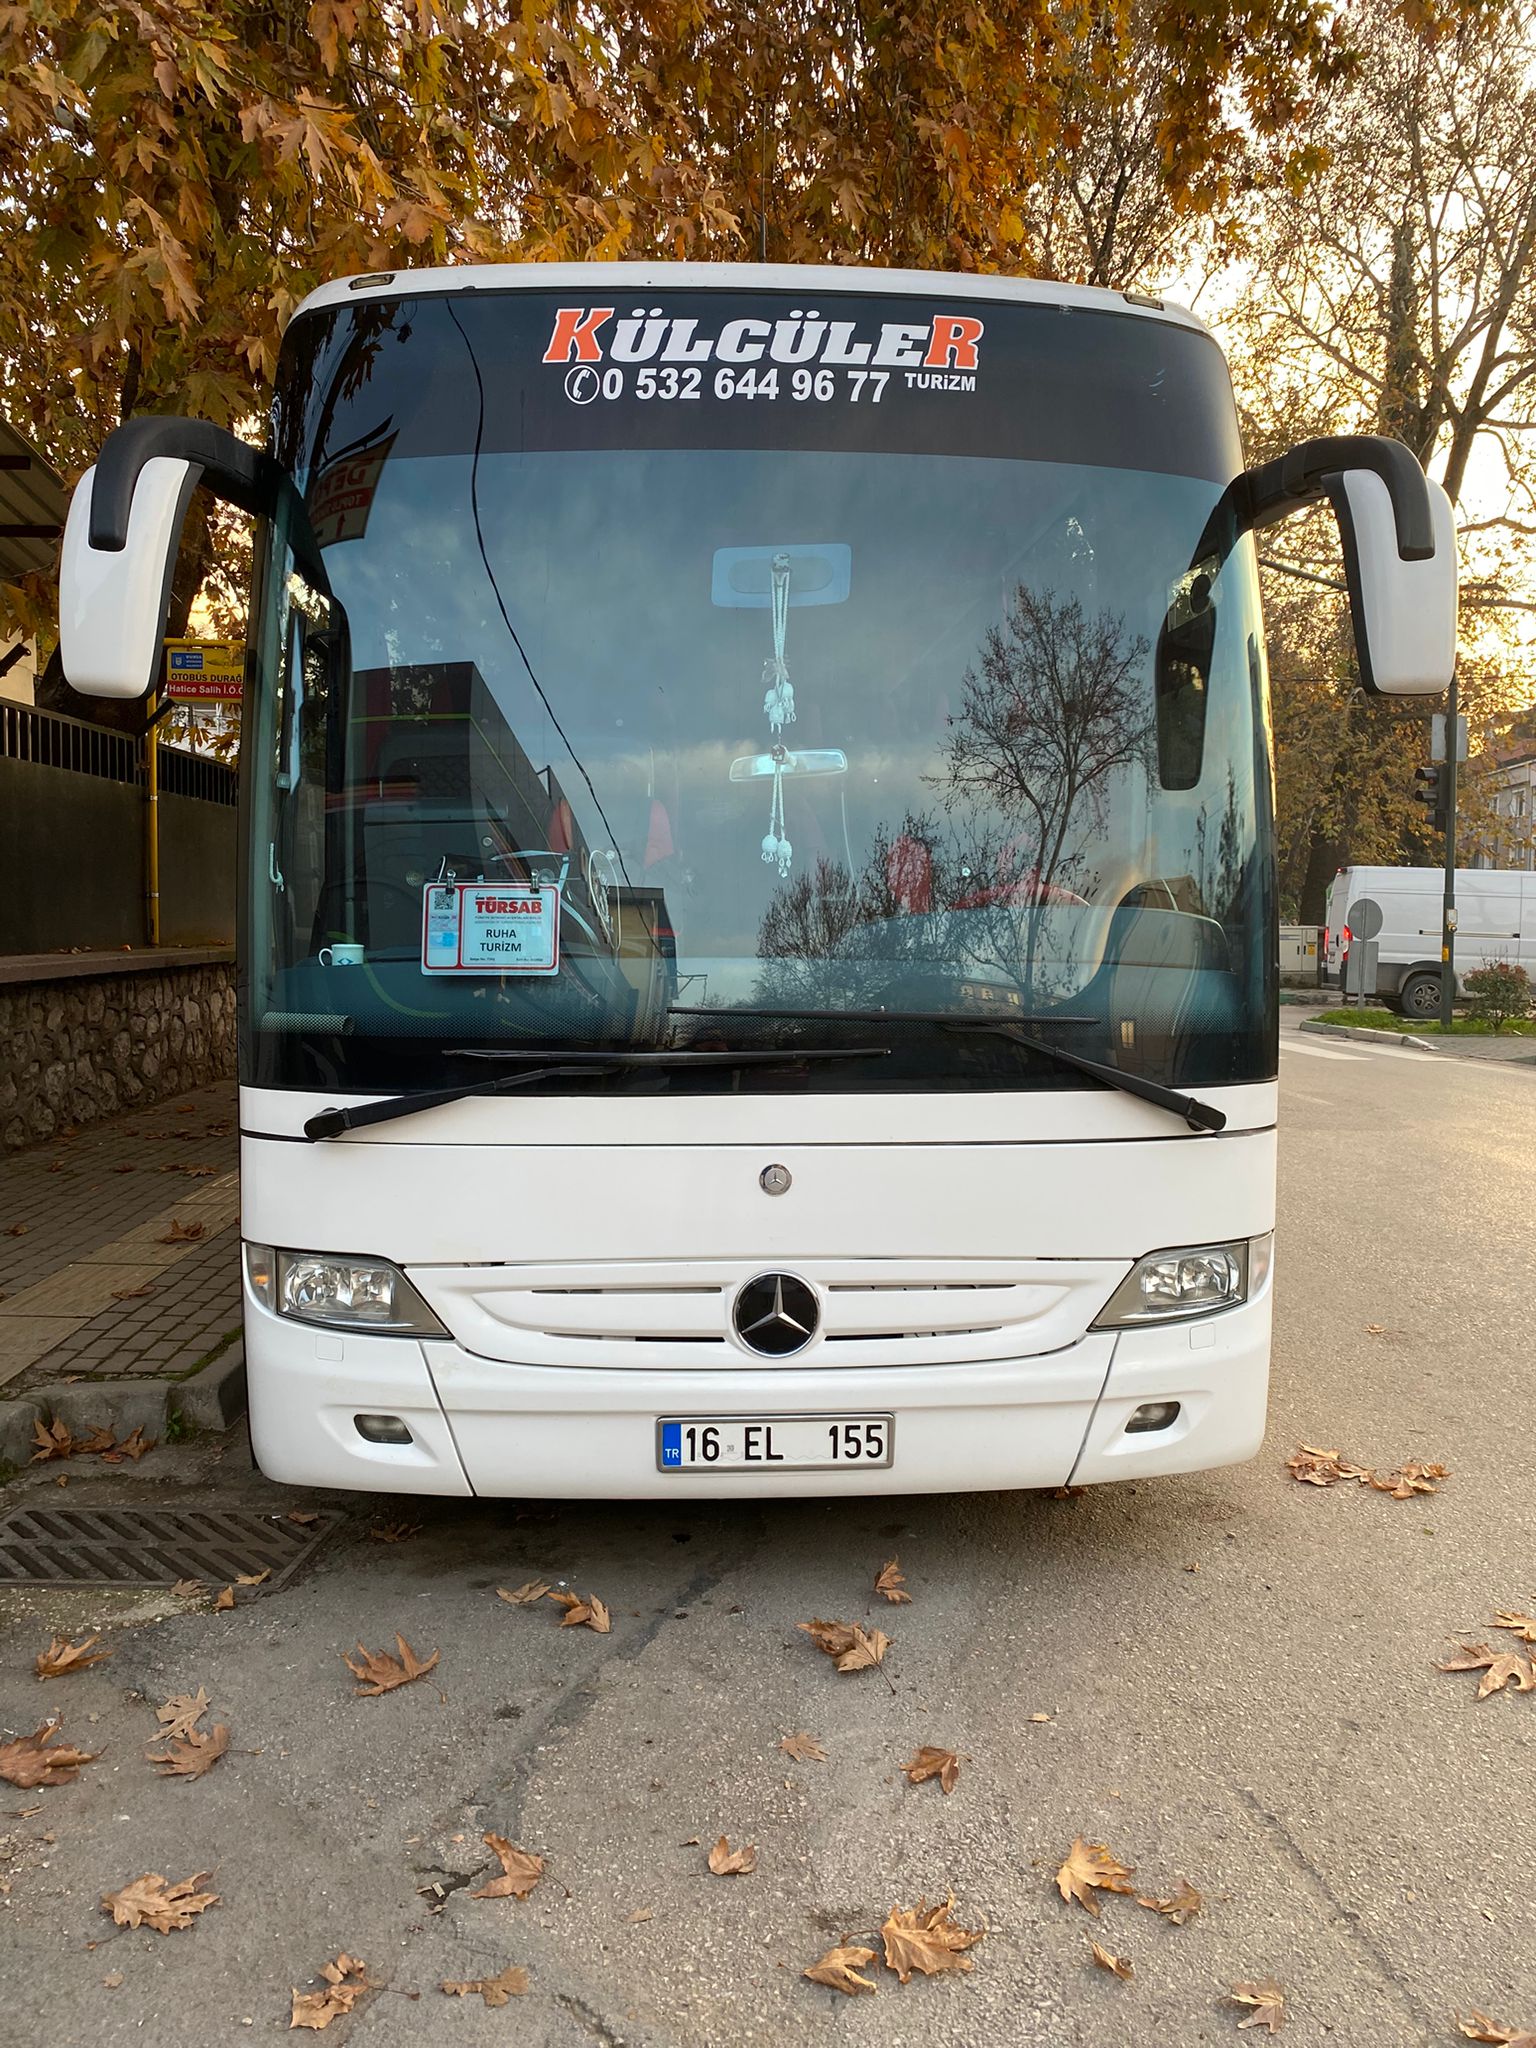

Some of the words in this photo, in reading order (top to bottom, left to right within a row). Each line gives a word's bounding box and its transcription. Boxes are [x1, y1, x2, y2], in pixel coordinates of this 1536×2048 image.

[602, 367, 624, 400] 0
[635, 367, 702, 400] 532
[714, 367, 779, 400] 644
[791, 368, 835, 401] 96
[847, 370, 890, 403] 77
[171, 672, 208, 682] OTOBÜS
[210, 673, 242, 683] DURAĞ
[168, 684, 197, 693] Hatice
[199, 685, 221, 694] Salih
[475, 896, 543, 914] TÜRSAB
[486, 929, 517, 939] RUHA
[480, 941, 522, 952] TURİZM
[686, 1427, 720, 1461] 16
[744, 1426, 784, 1460] EL
[829, 1425, 883, 1459] 155
[665, 1449, 679, 1459] TR
